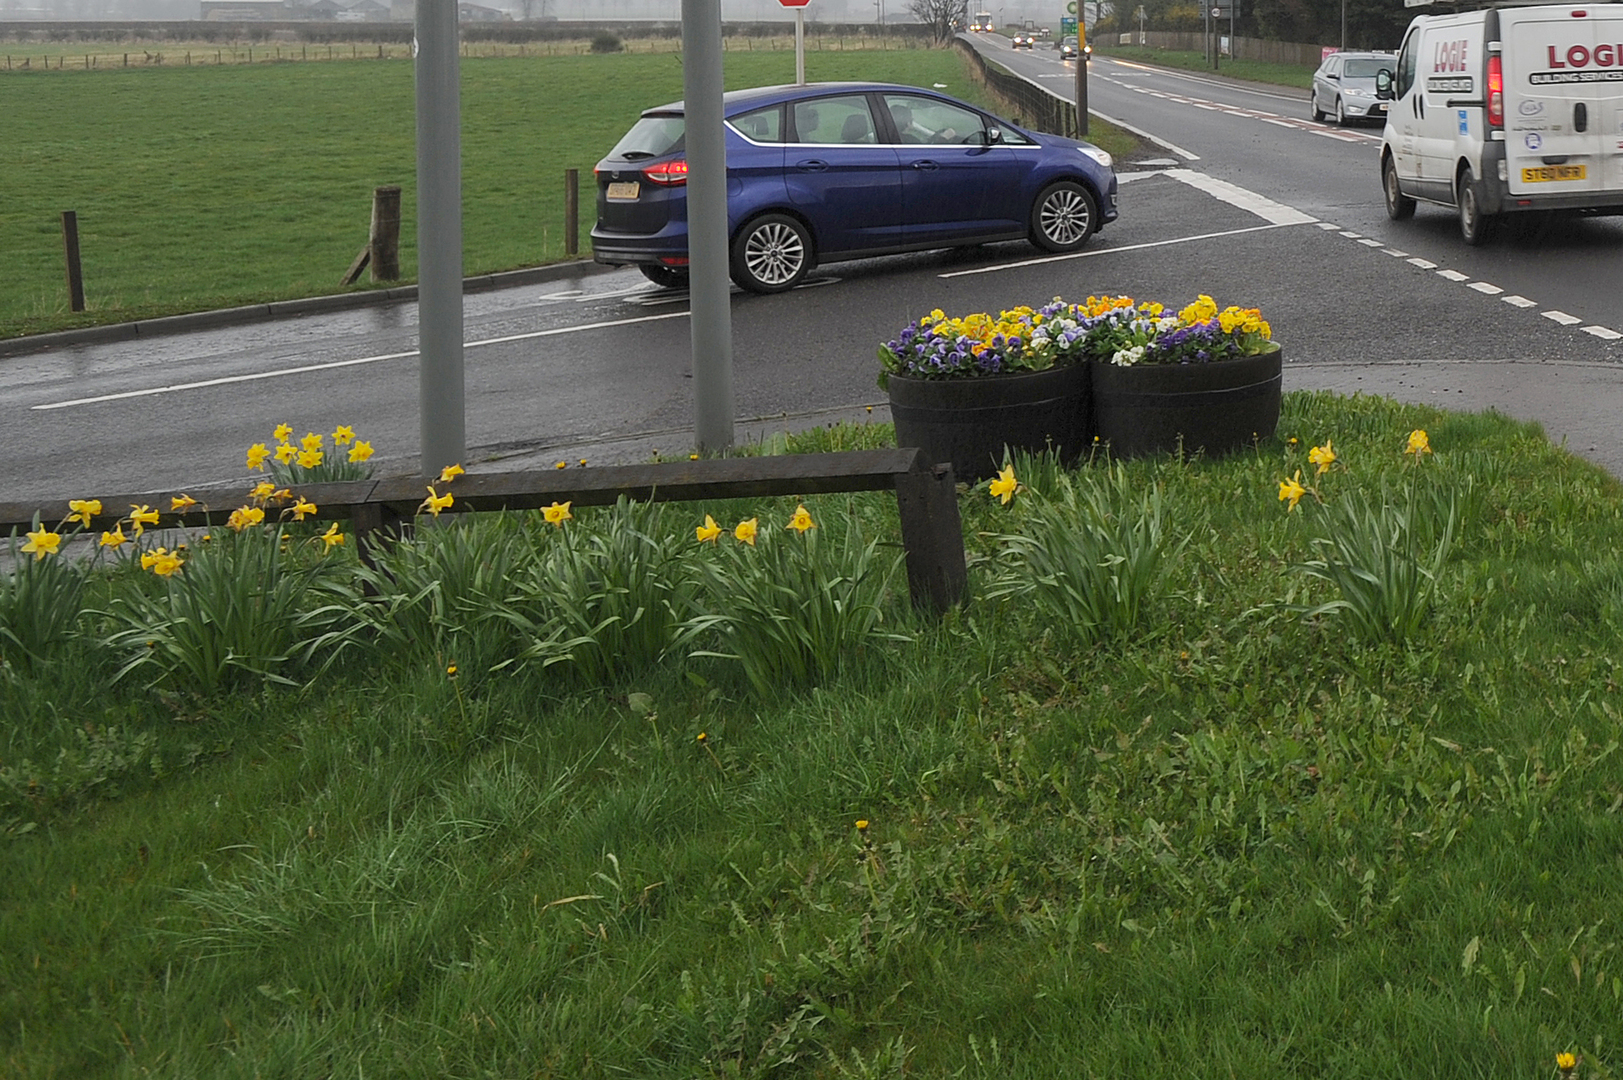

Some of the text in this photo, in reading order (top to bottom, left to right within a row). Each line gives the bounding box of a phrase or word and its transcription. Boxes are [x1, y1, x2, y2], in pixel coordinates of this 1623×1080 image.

[1434, 40, 1468, 72] LOGIE
[1531, 74, 1579, 83] BUILDING
[1580, 72, 1623, 81] SERVICES
